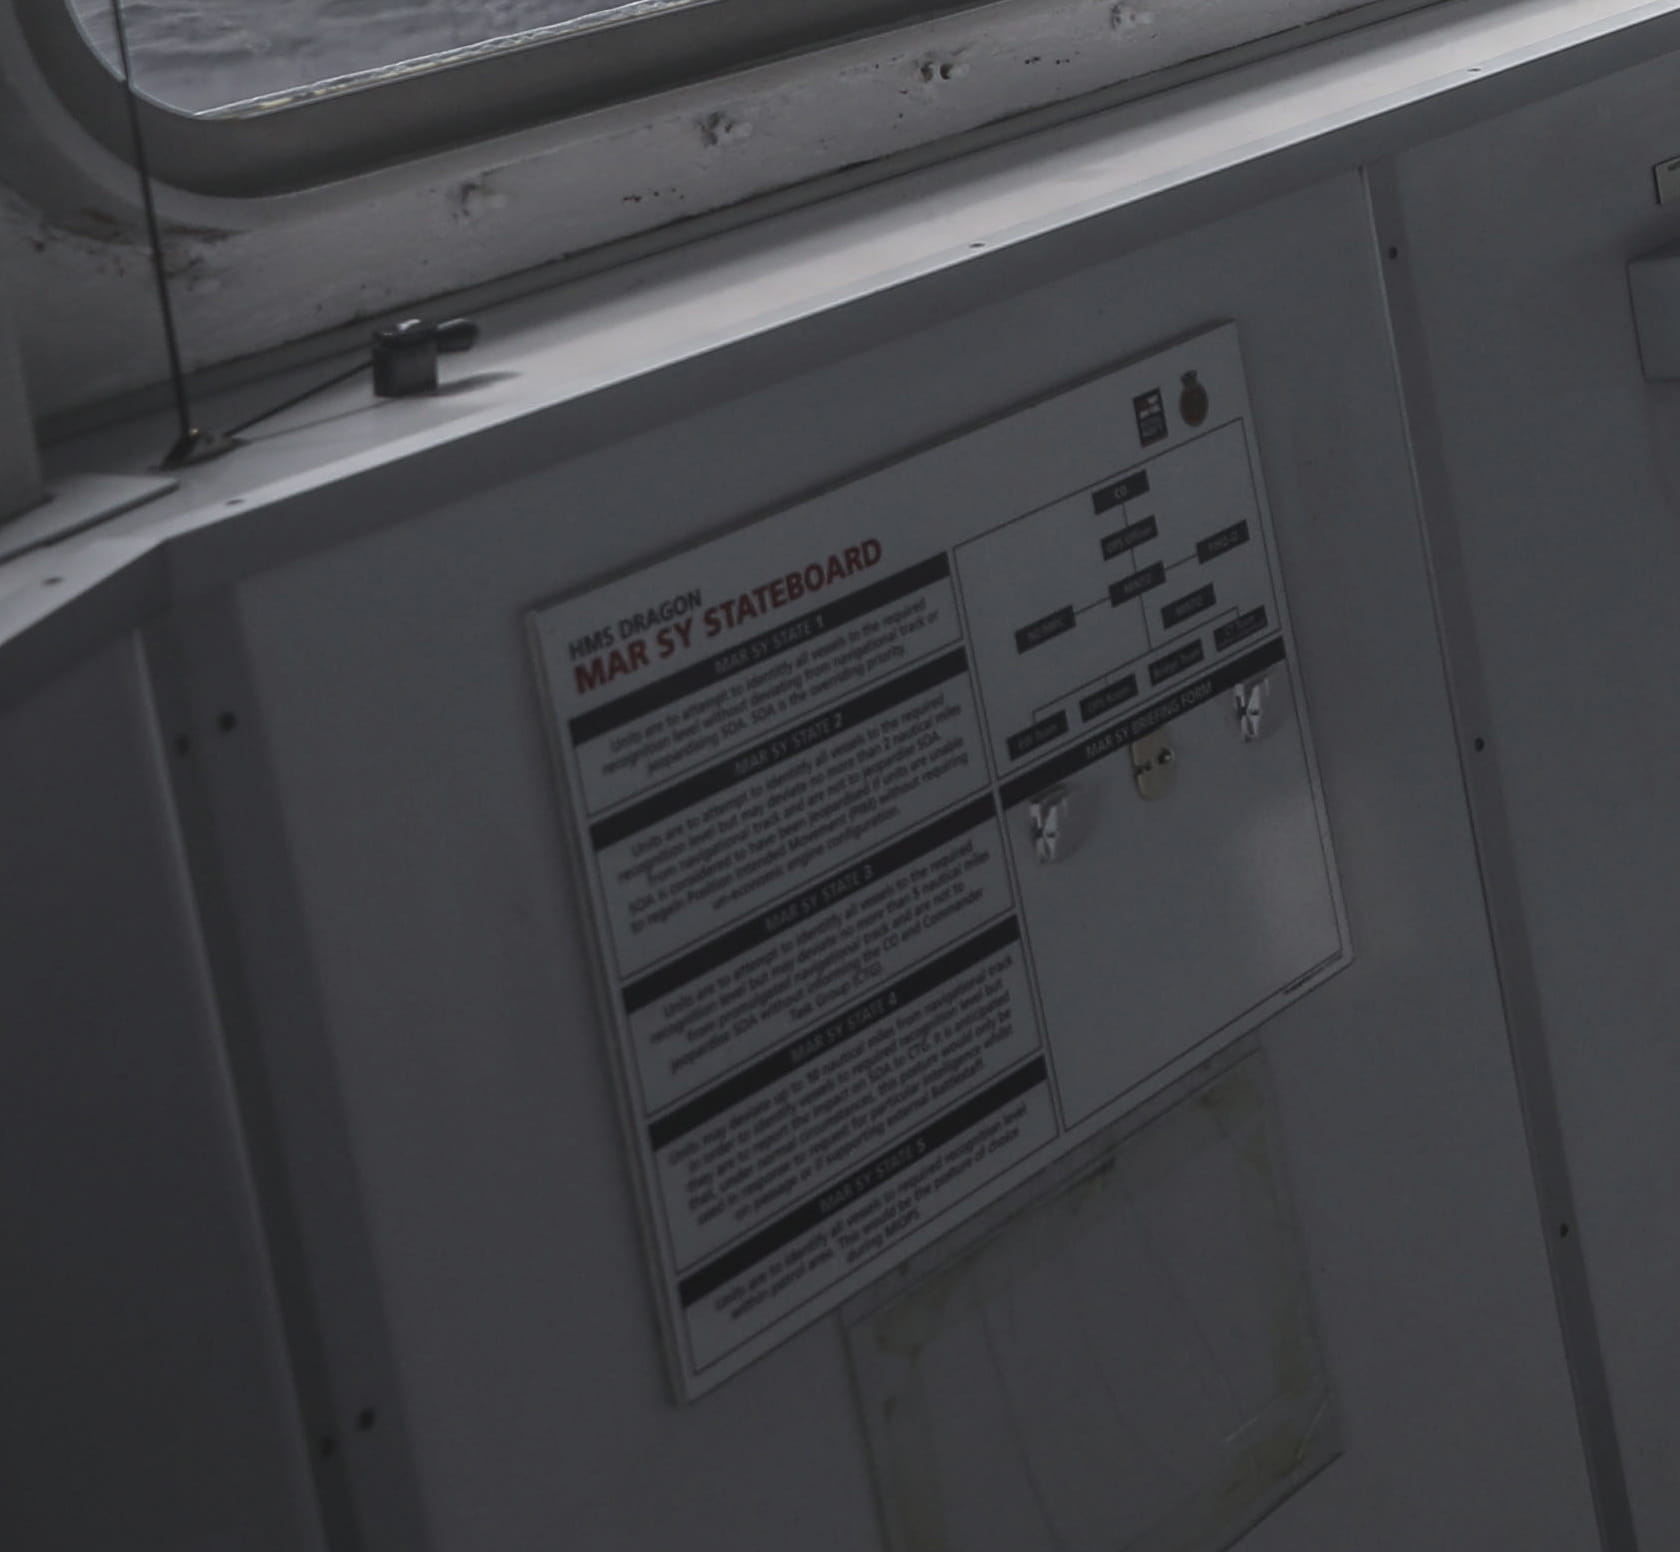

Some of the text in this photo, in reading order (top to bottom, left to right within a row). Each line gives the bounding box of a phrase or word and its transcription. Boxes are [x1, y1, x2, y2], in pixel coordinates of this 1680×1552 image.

[570, 589, 702, 660] HMS DRAGON
[574, 537, 883, 696] MAR SY STATEBOARD
[713, 614, 825, 674] MAR SY STATE 1
[733, 712, 844, 776] MAR SY STATE 2
[1084, 733, 1113, 760] MAR
[1113, 724, 1129, 744] SY
[1129, 697, 1181, 736] BRIEFING
[1180, 678, 1213, 708] FORM
[763, 864, 874, 933] MAR SY STATE 3
[789, 991, 898, 1064] MAR SY STATE 4
[818, 1137, 927, 1215] MAR SY STATE 5
